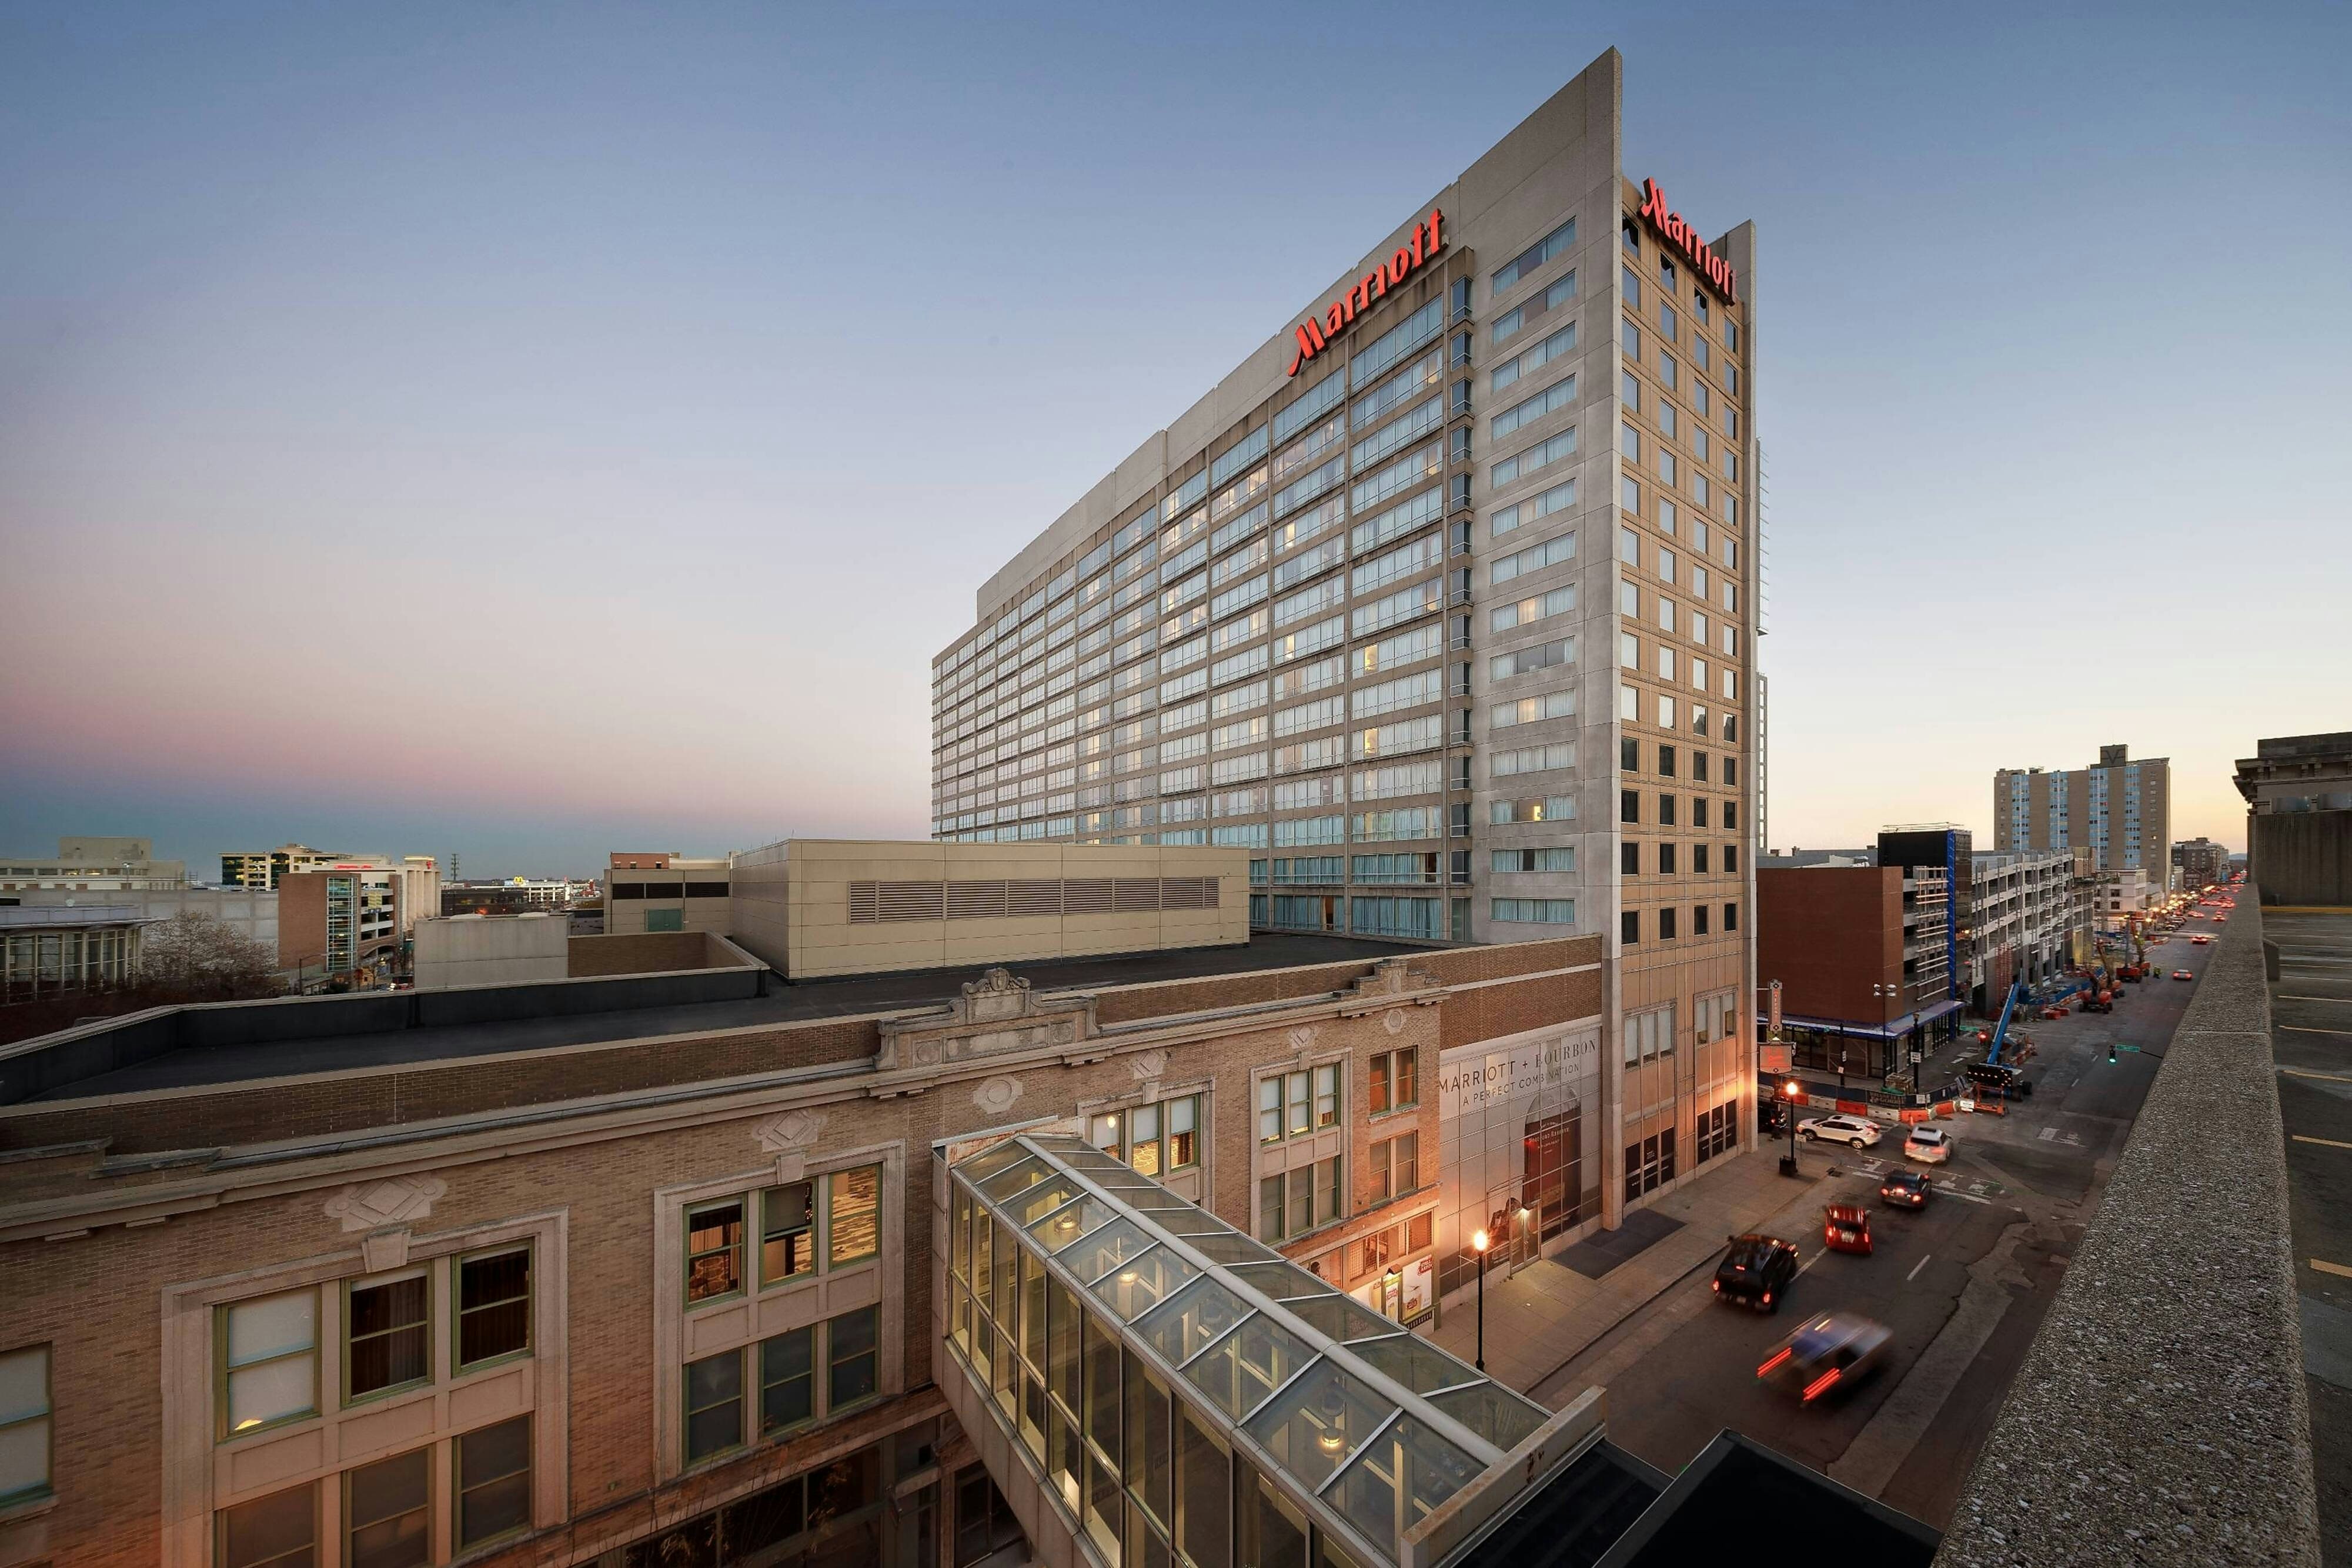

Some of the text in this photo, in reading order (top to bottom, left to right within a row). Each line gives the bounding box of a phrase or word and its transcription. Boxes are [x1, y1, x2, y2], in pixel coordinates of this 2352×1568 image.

[1641, 177, 1738, 305] Marriott
[1288, 208, 1445, 377] Marriott
[1439, 1061, 1516, 1094] MARRIOTT
[1535, 1039, 1596, 1068] BOURBON
[1462, 1064, 1579, 1106] A PERFECT COMBNATION
